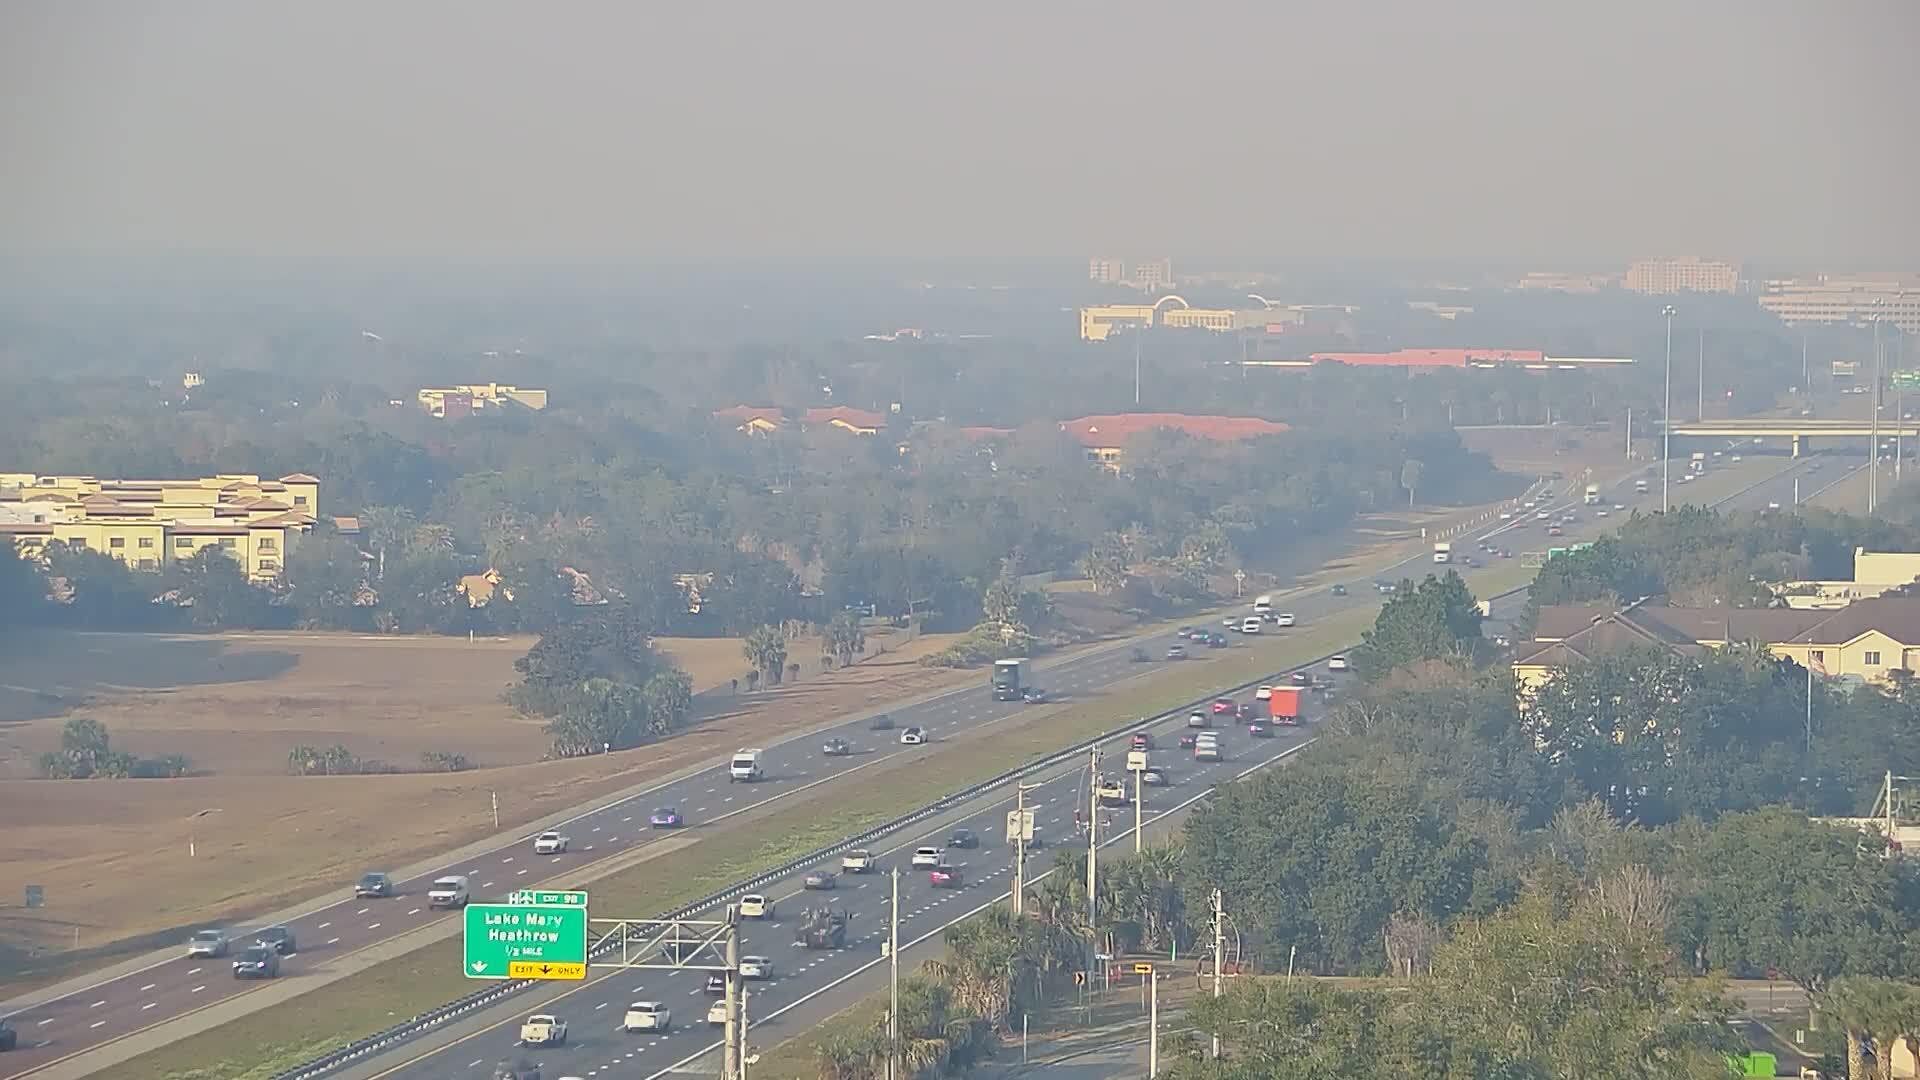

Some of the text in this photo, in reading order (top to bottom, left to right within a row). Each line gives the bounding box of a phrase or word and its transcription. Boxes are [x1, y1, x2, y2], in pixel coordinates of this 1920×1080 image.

[485, 912, 563, 928] Lake Mary
[488, 928, 559, 942] Heathrow
[505, 945, 519, 956] 1/2
